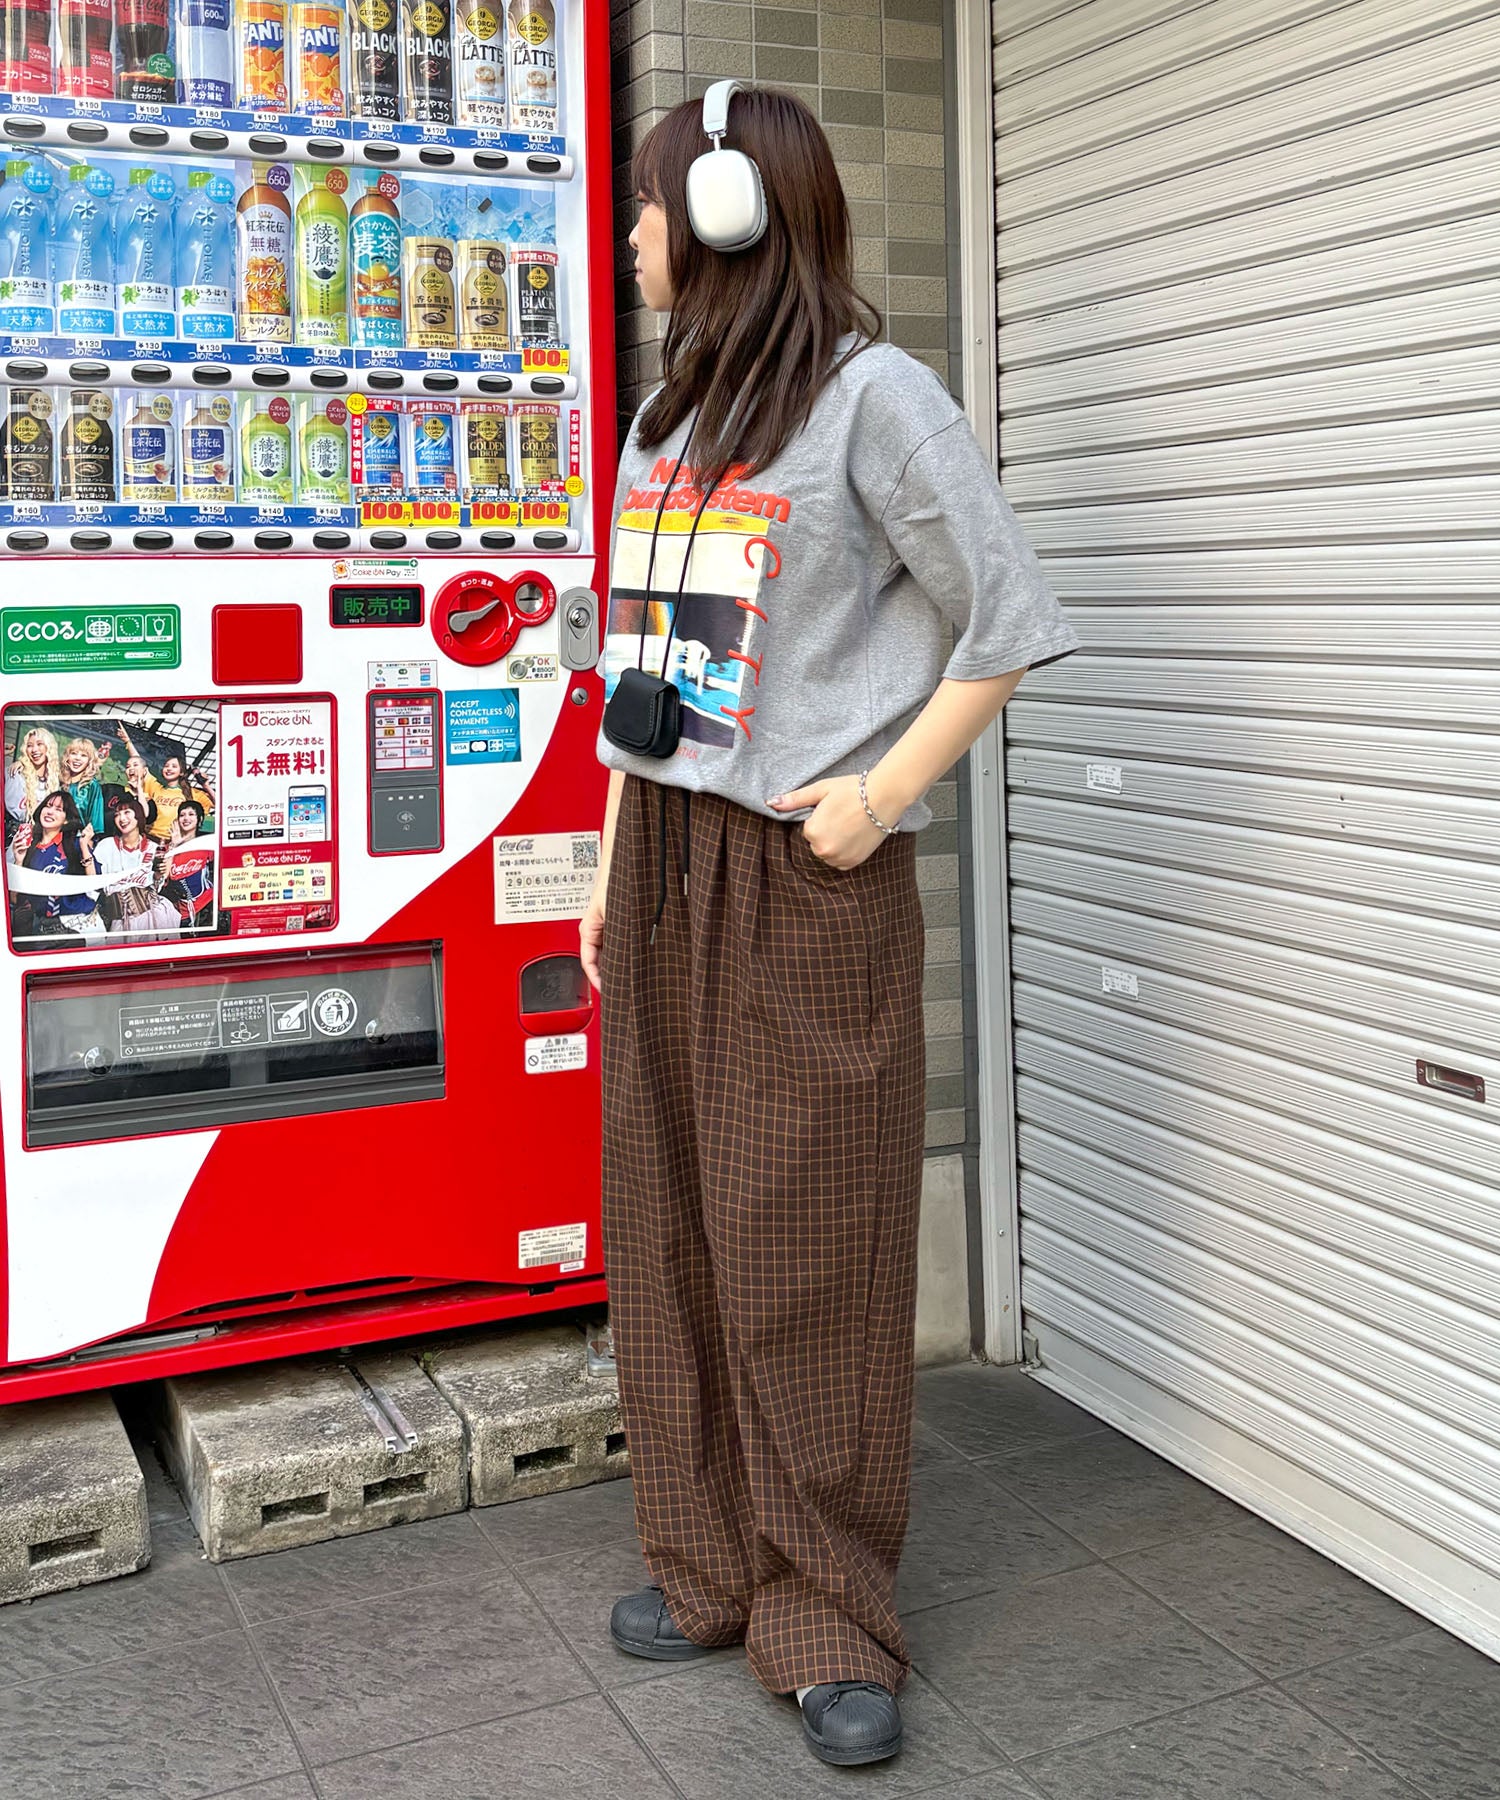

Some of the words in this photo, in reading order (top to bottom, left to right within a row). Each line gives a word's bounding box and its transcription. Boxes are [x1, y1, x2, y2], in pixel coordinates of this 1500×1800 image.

[467, 19, 497, 28] GEORGIA
[519, 25, 547, 33] GEORGIA
[243, 19, 283, 43] FANT
[299, 25, 339, 48] FANT
[351, 32, 397, 55] BLACK
[406, 37, 450, 59] BLACK
[462, 44, 504, 65] LATTE
[513, 49, 555, 69] LATTE
[356, 95, 395, 106] 飲みやすく
[411, 99, 449, 111] 飲みやすく
[363, 106, 395, 117] 深いコク
[467, 103, 501, 115] 軽やかな
[520, 108, 552, 119] 軽やかな
[417, 110, 450, 121] 深いコク
[246, 220, 285, 233] 紅茶花伝
[312, 222, 334, 267] 綾鷹
[353, 230, 399, 259] 麦茶
[521, 296, 555, 310] BLACK
[9, 314, 45, 327] 天然水
[70, 316, 107, 328] 天然水
[133, 319, 168, 331] 天然水
[192, 321, 226, 333] 天然水
[523, 348, 569, 367] 100円
[258, 436, 275, 468] 綾鷹
[469, 441, 504, 451] GOLDEN
[522, 441, 557, 452] GOLDEN
[316, 437, 333, 469] 綾鷹
[362, 502, 411, 520] 100円
[412, 502, 460, 520] 100円
[471, 503, 518, 520] 100円
[522, 503, 567, 520] 100円
[386, 568, 401, 578] Pay
[343, 596, 410, 616] 販売中
[537, 657, 550, 665] OK
[450, 700, 480, 709] ACCEPT
[450, 707, 503, 718] CONTACTLESS
[259, 716, 290, 726] Coke
[450, 717, 489, 726] PAYMENTS
[266, 736, 325, 747] スタンプたまると
[257, 855, 279, 864] Coke
[294, 854, 312, 864] Pay
[229, 894, 247, 902] VISA
